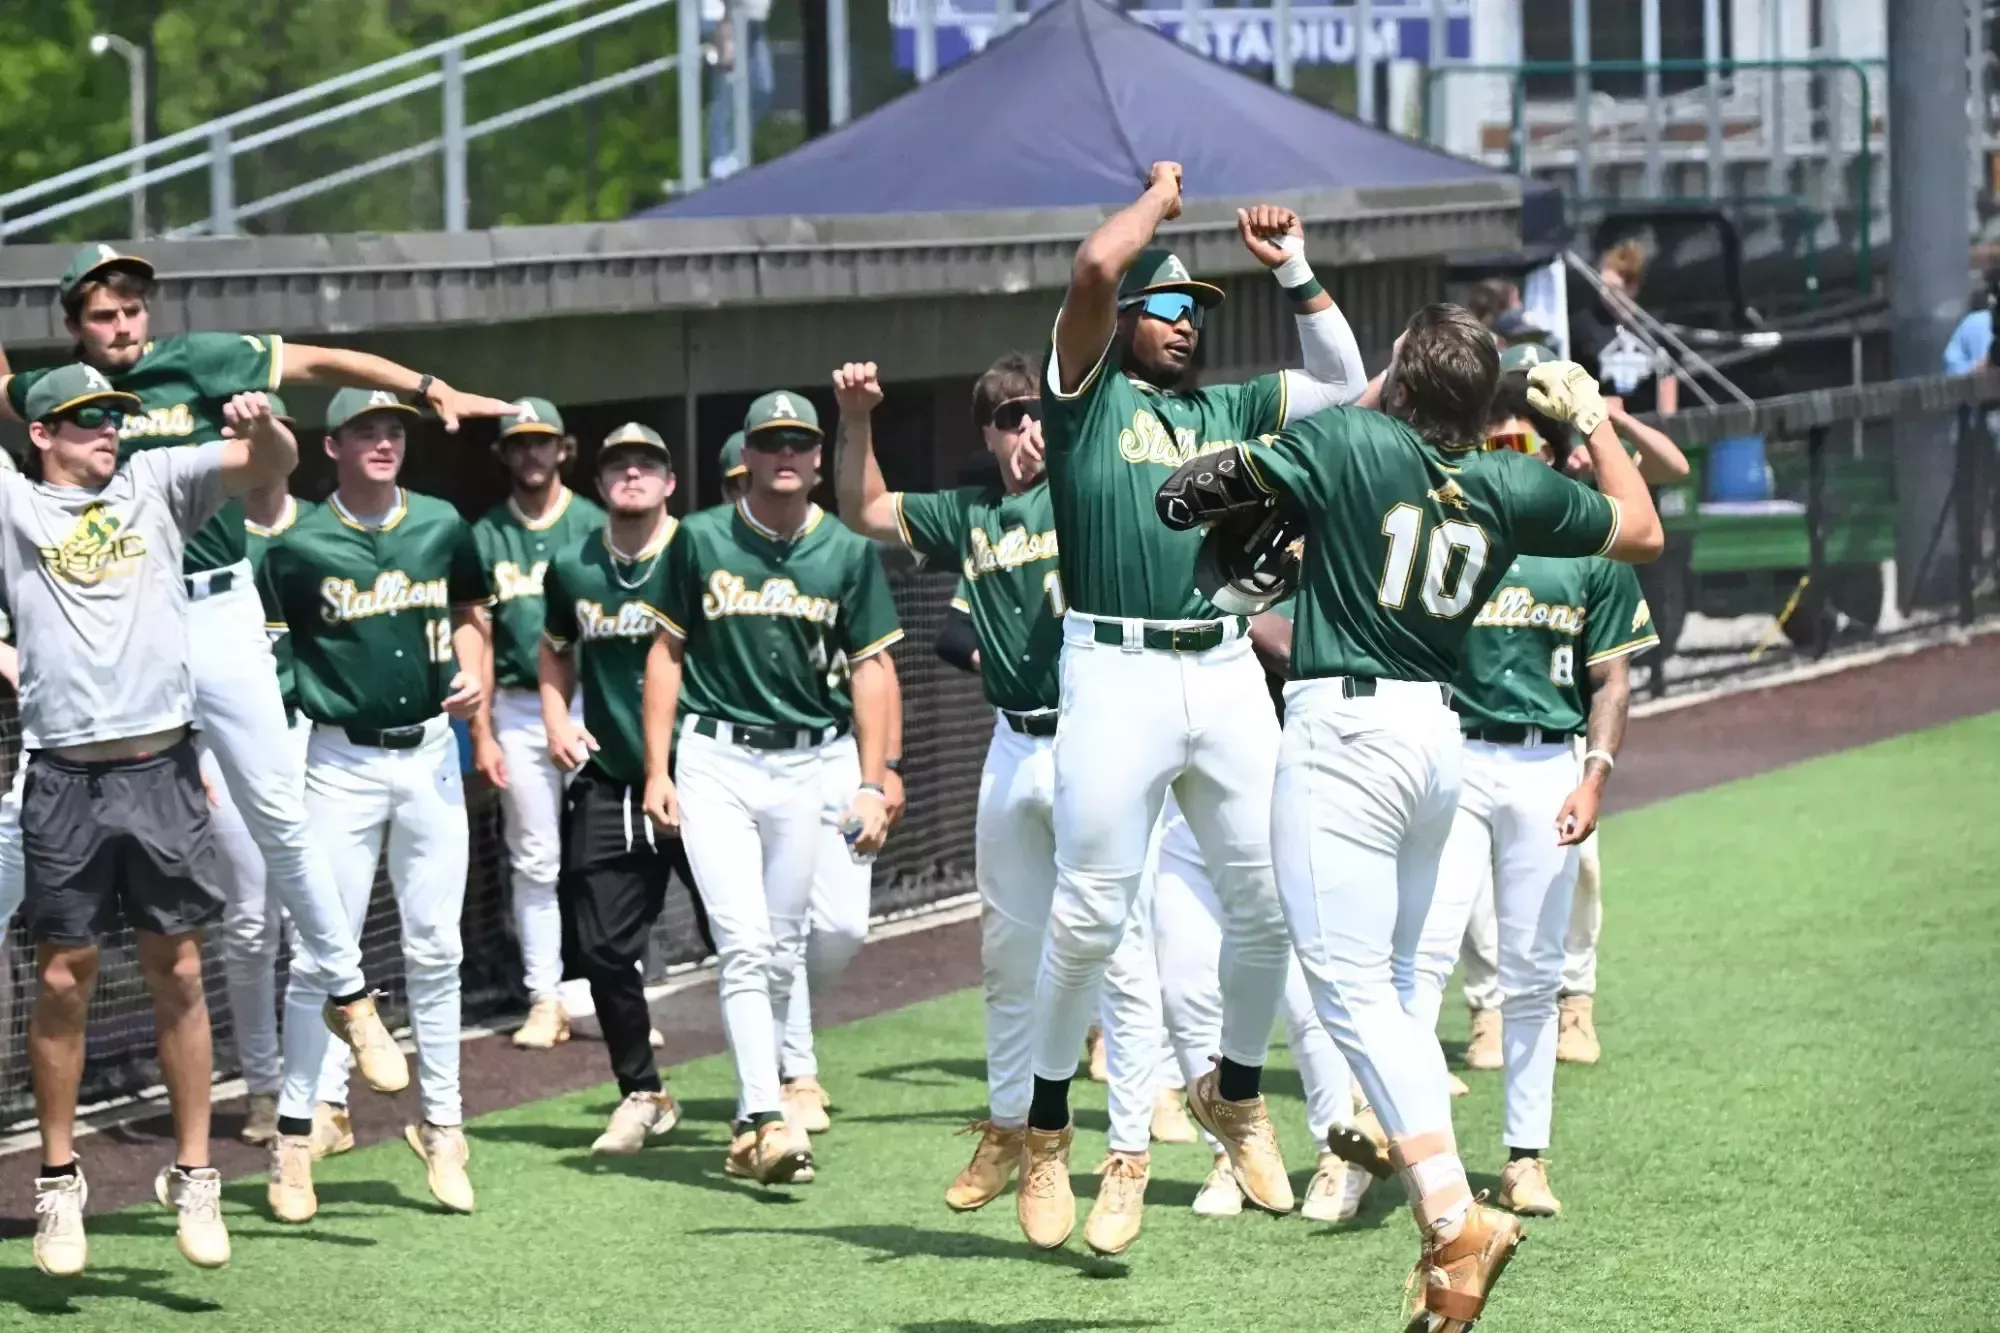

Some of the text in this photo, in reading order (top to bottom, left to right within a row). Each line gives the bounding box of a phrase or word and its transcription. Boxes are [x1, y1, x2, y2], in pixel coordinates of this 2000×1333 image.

[1168, 254, 1192, 282] A
[83, 365, 114, 390] A
[772, 394, 798, 418] A
[1377, 501, 1491, 620] 10
[1471, 585, 1587, 637] allions
[1551, 643, 1575, 688] 8
